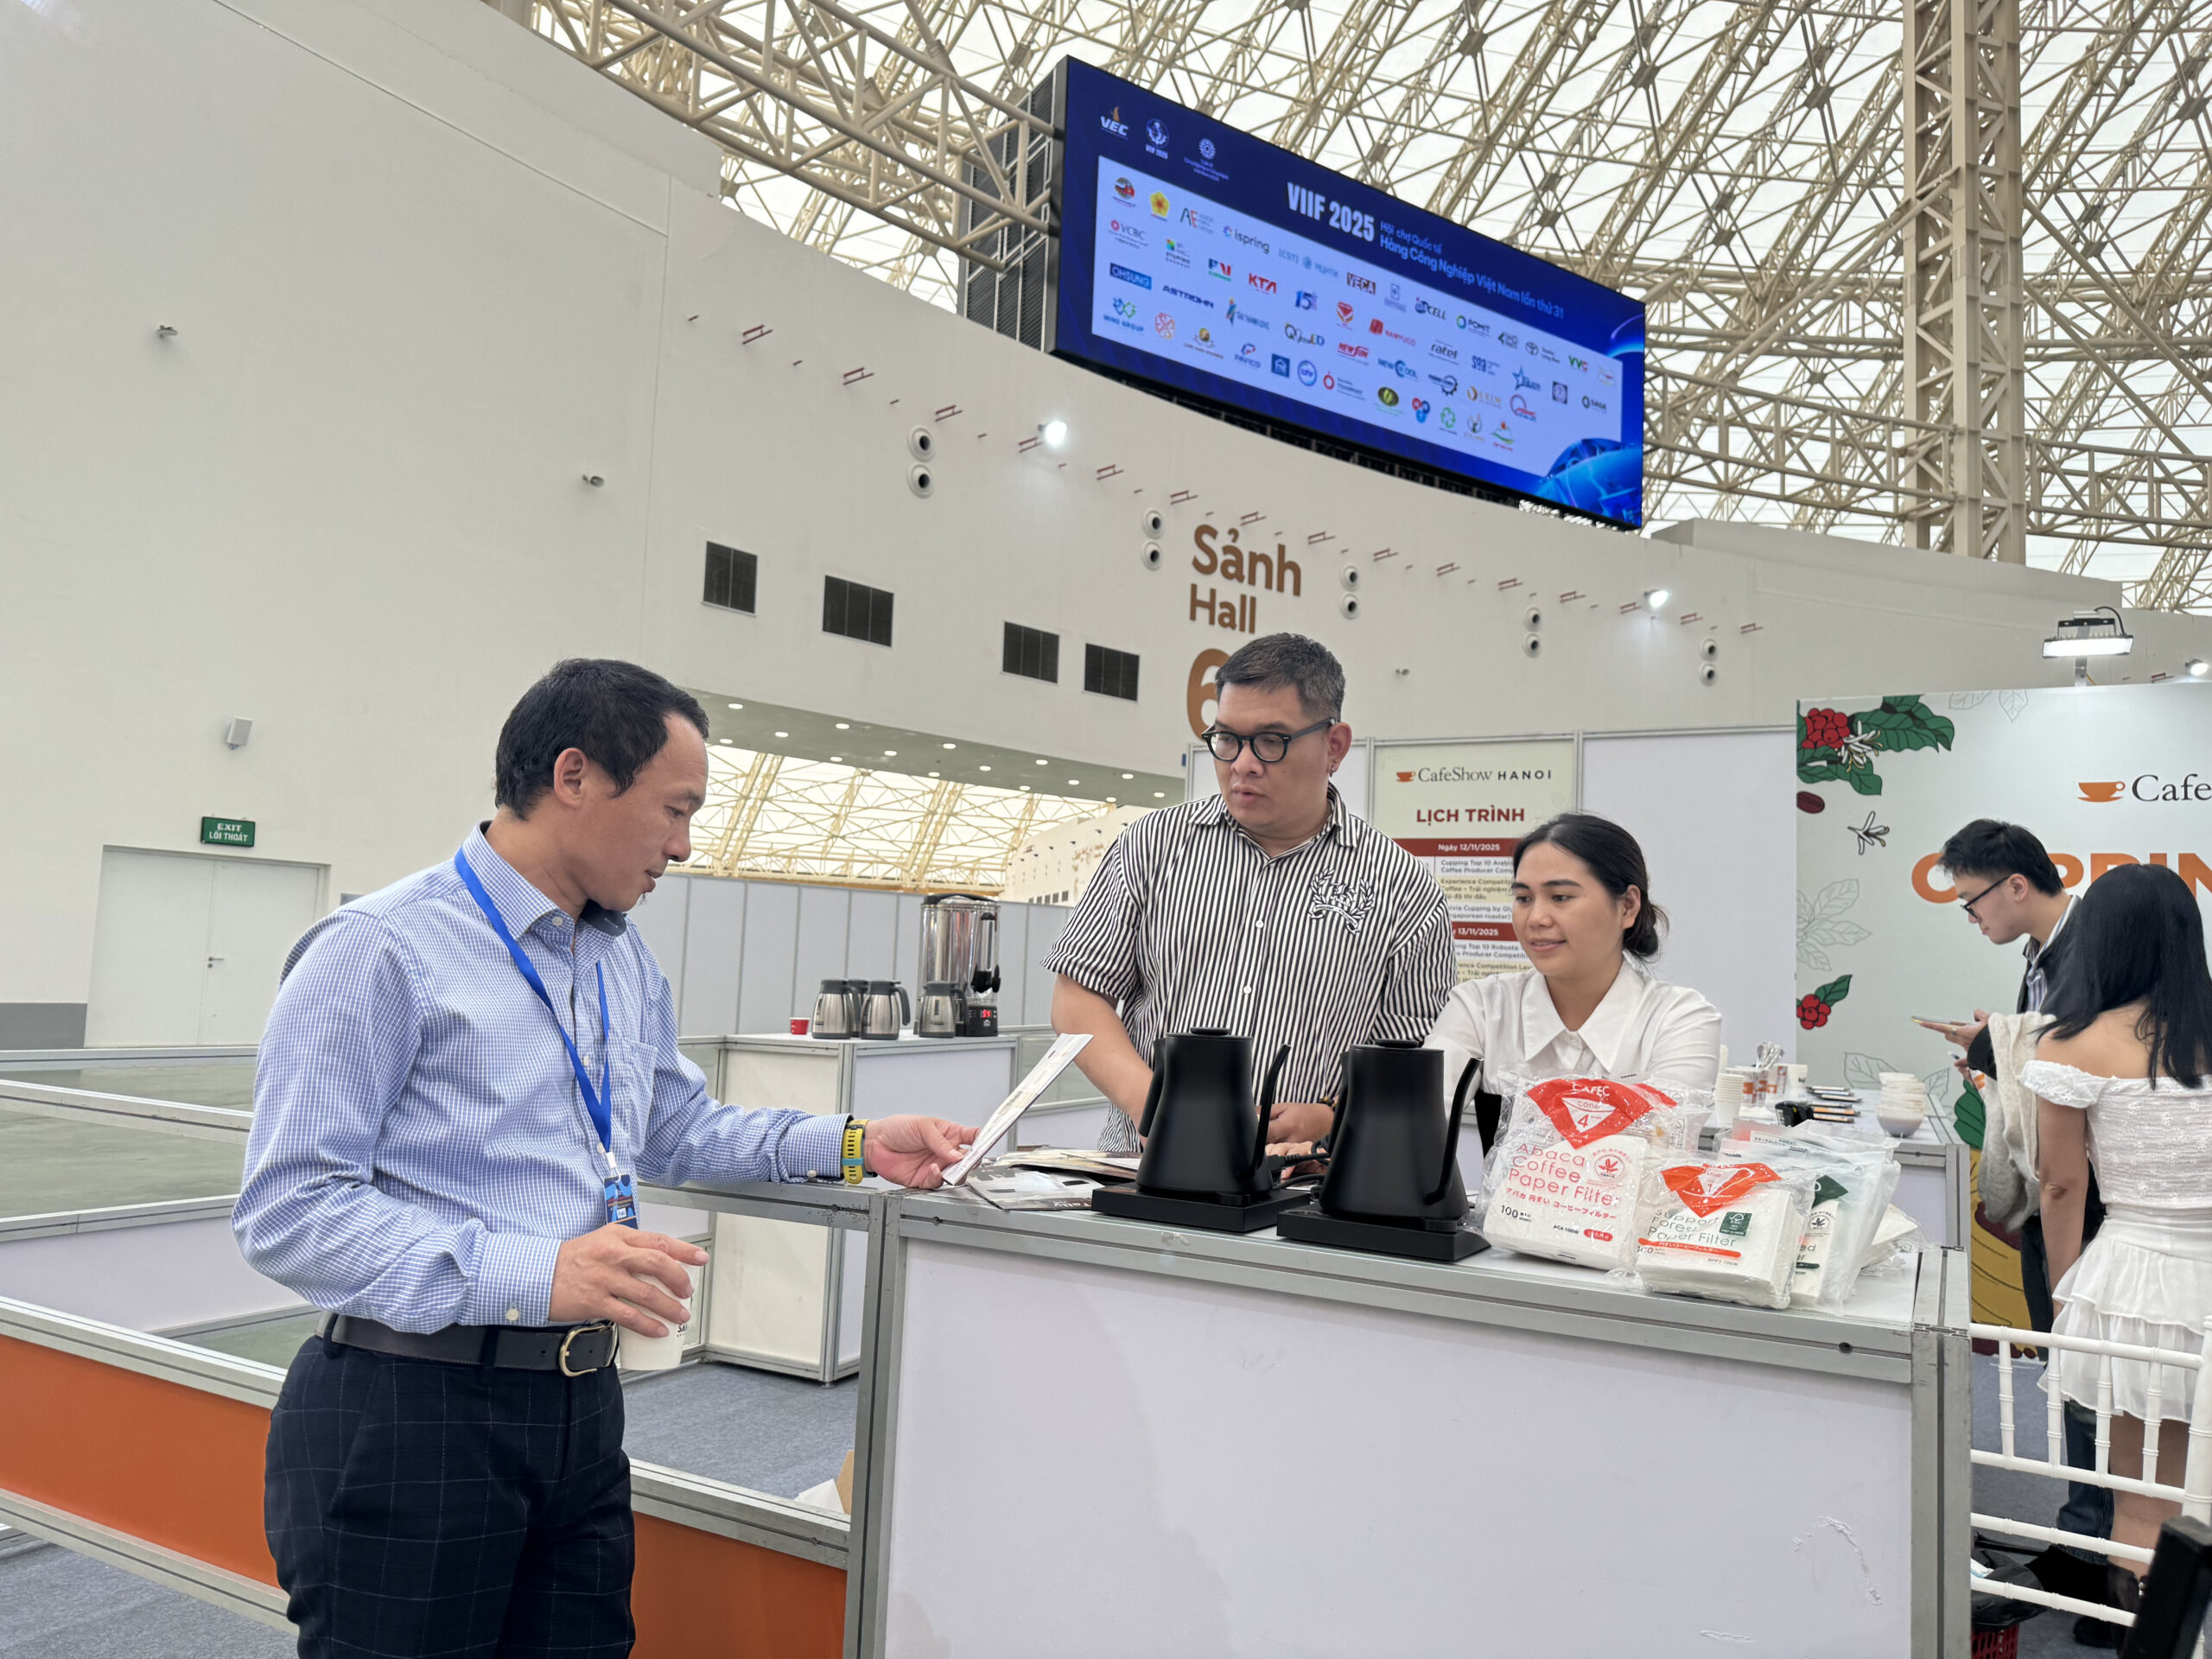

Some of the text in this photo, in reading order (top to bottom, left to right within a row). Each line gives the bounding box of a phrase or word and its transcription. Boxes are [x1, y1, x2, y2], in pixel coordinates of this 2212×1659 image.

[1100, 116, 1129, 136] VEC
[1287, 182, 1375, 242] VIIF 2025
[1439, 259, 1475, 285] Nghiệp
[1477, 273, 1497, 294] Việt
[1497, 283, 1520, 302] Nam
[1554, 305, 1564, 320] 31
[1192, 524, 1301, 596] Sảnh
[1190, 583, 1256, 634] Hall
[1418, 766, 1552, 783] CafeShow HANOI
[1416, 804, 1525, 826] LỊCH TRÌNH
[217, 823, 242, 832] EXIT
[1438, 843, 1458, 853] Ngày
[1458, 927, 1499, 937] 13/11/2025
[1572, 1081, 1611, 1097] CAFEC
[1578, 1114, 1589, 1128] 4
[1516, 1142, 1585, 1167] Abaca
[1512, 1155, 1580, 1183] Coffee
[1509, 1168, 1569, 1196] Paper
[1501, 1205, 1518, 1218] 100
[1655, 1209, 1719, 1225] Support
[1698, 1232, 1737, 1247] Filter
